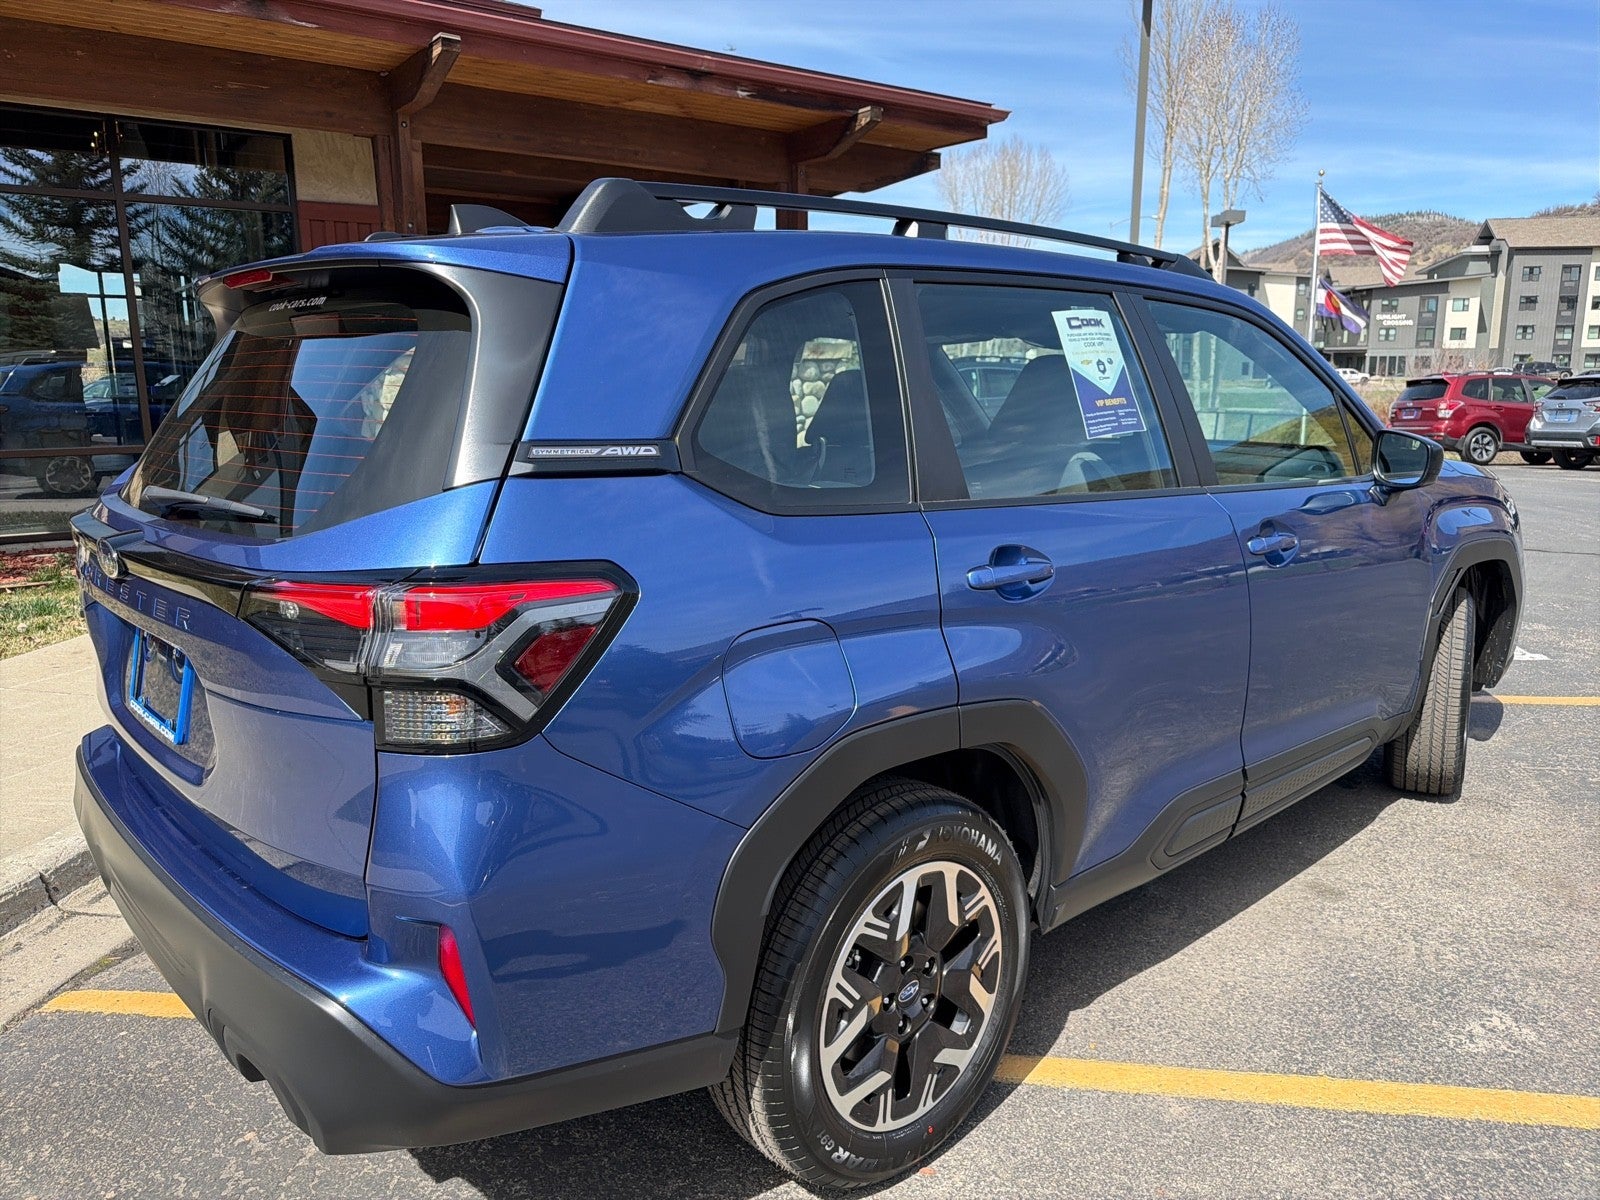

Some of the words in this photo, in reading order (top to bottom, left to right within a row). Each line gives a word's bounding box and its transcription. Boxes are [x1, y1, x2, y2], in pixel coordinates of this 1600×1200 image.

[268, 296, 327, 312] cook-cars.com
[1095, 399, 1105, 407] VIP
[1105, 397, 1127, 406] BENEFITS
[601, 446, 657, 456] AWD
[939, 826, 1002, 866] YOKOHAMA
